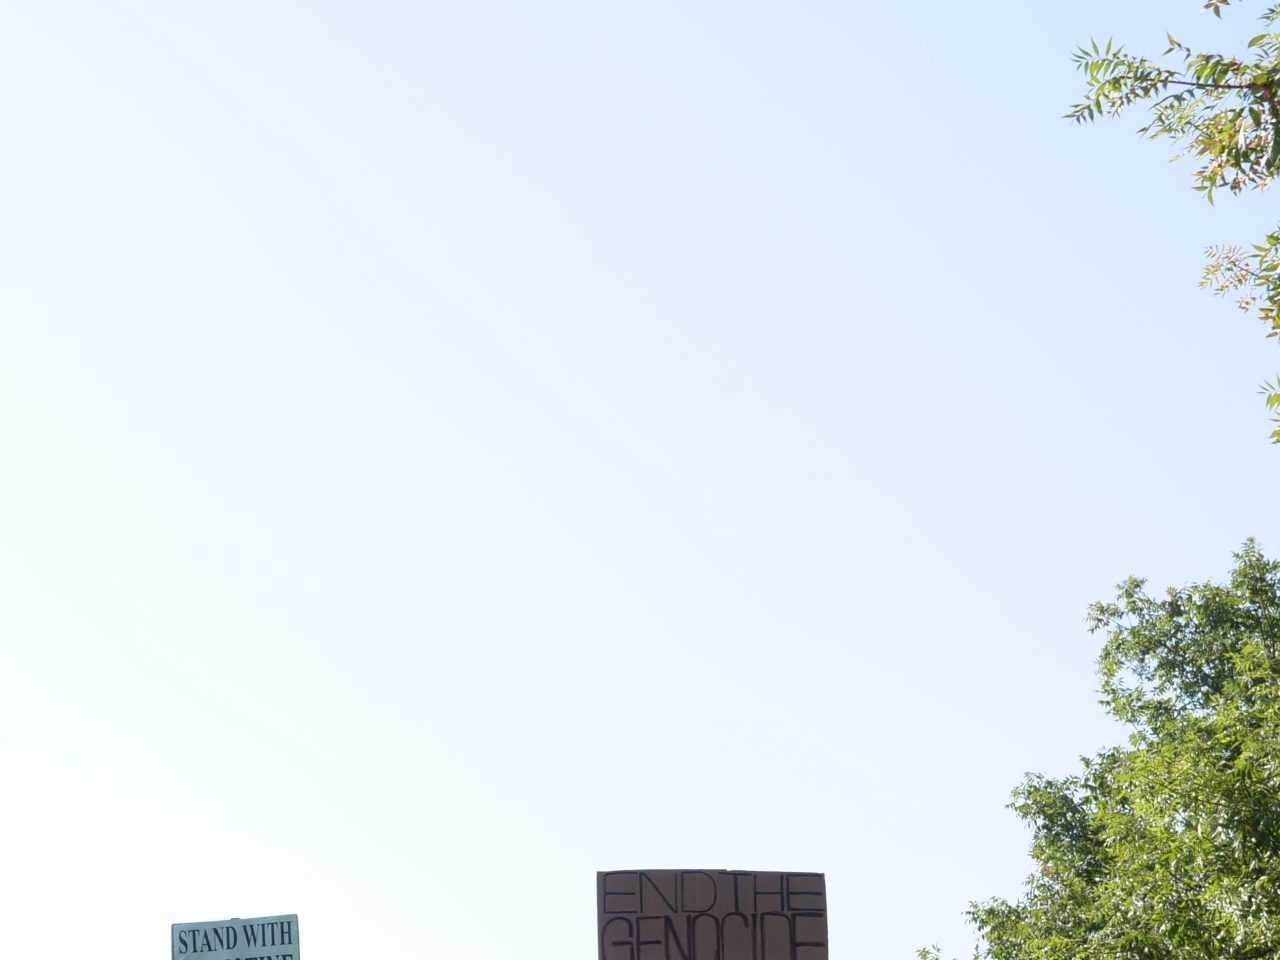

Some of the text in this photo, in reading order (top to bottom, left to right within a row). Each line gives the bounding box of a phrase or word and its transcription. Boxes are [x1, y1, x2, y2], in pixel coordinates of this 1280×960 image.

[603, 871, 825, 913] END THE
[178, 920, 293, 954] STAND WITH
